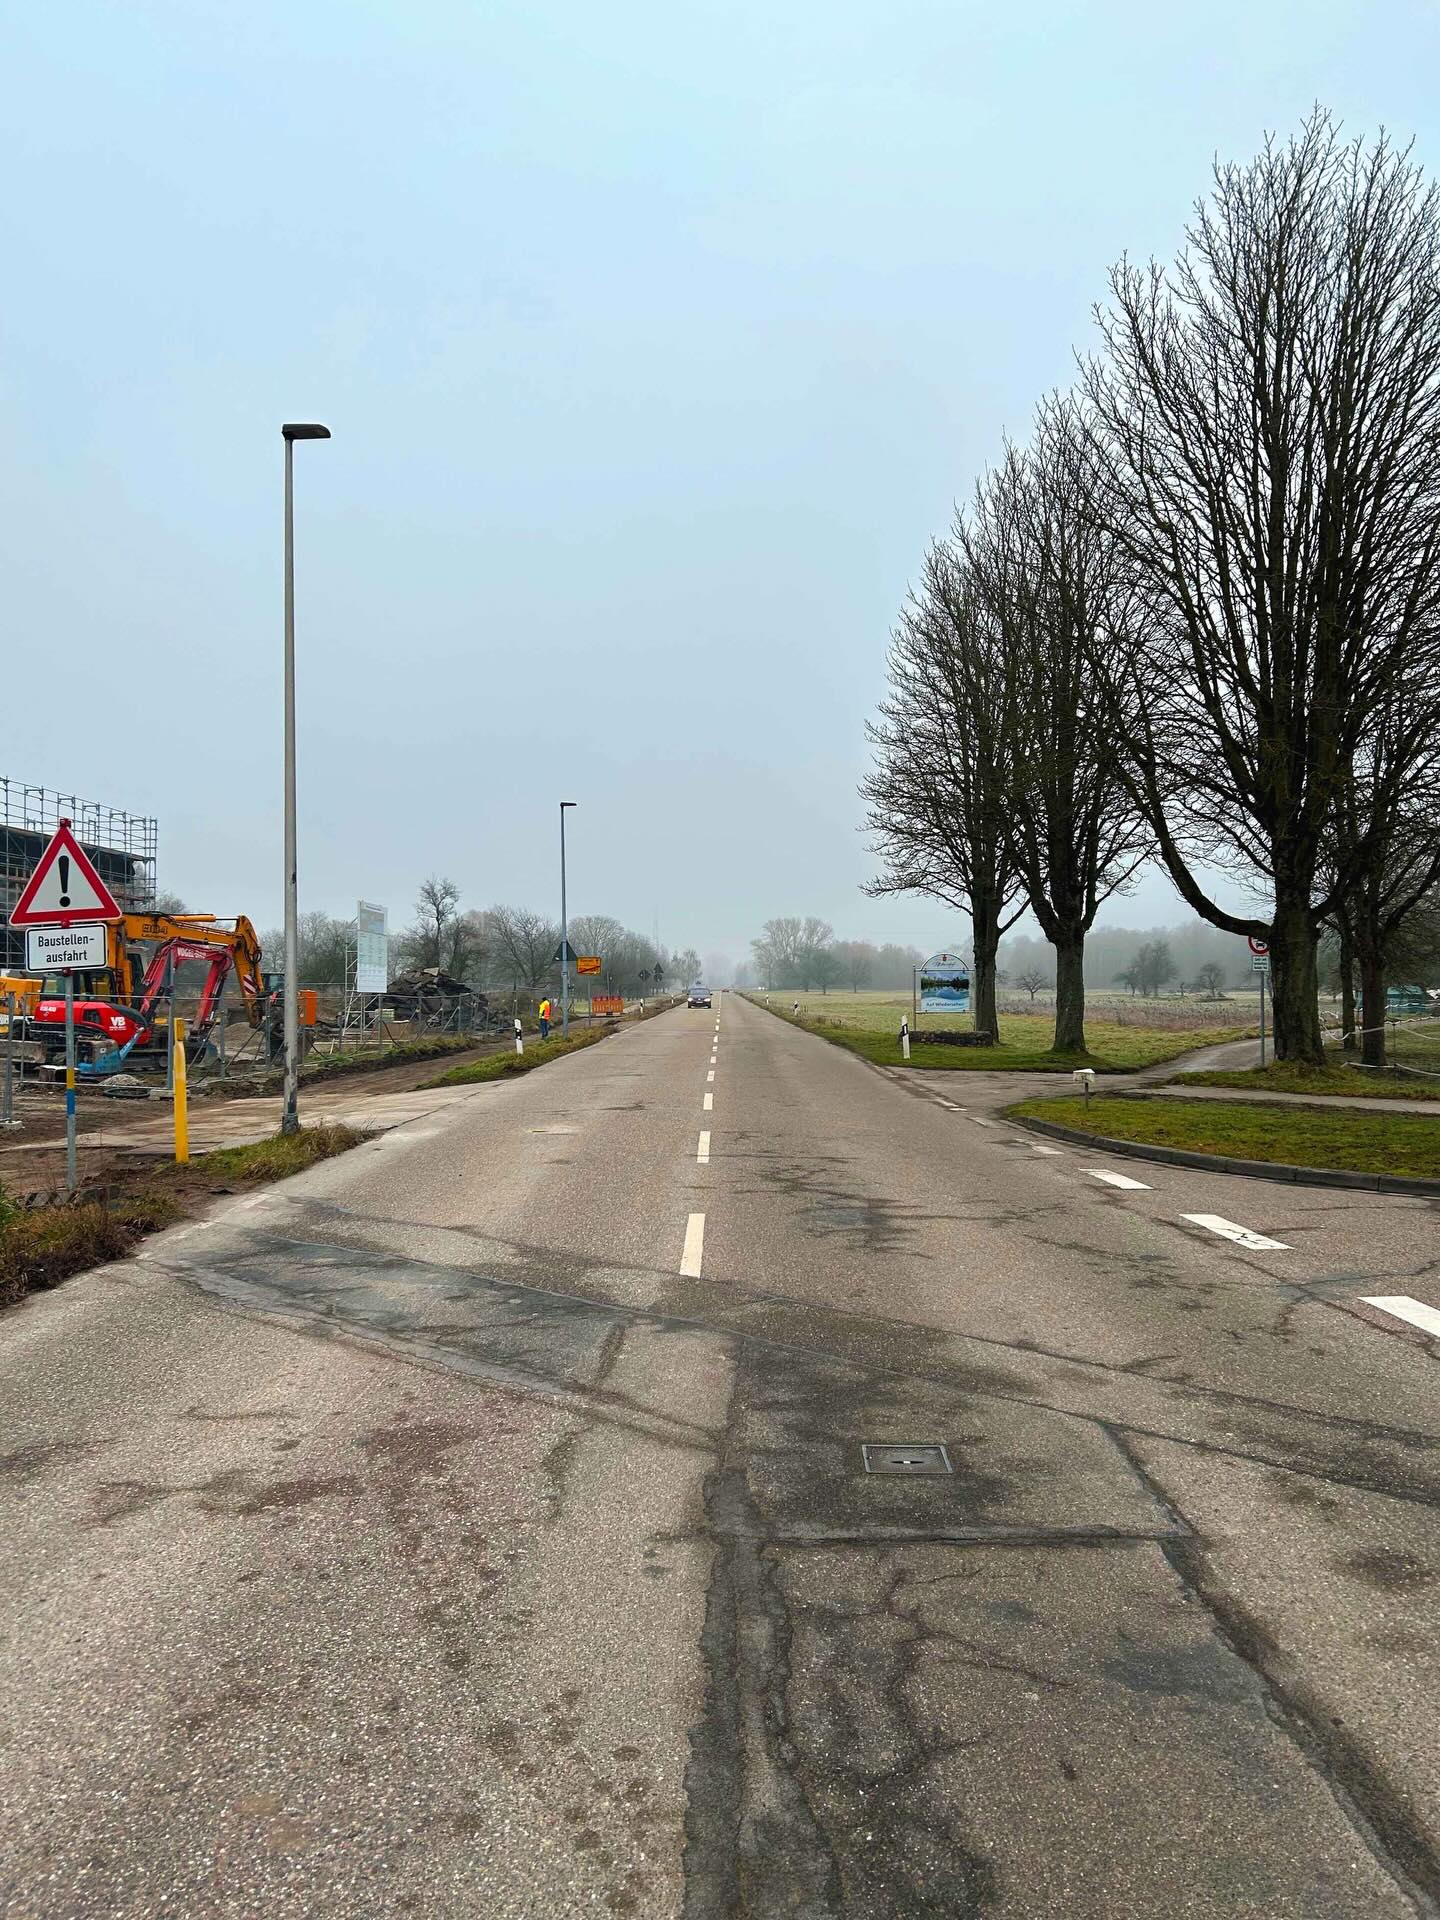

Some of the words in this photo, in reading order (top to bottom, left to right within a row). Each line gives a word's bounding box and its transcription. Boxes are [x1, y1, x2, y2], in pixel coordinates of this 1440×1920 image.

[38, 934, 95, 947] Baustellen-
[46, 950, 88, 963] ausfahrt
[110, 1016, 125, 1026] VB
